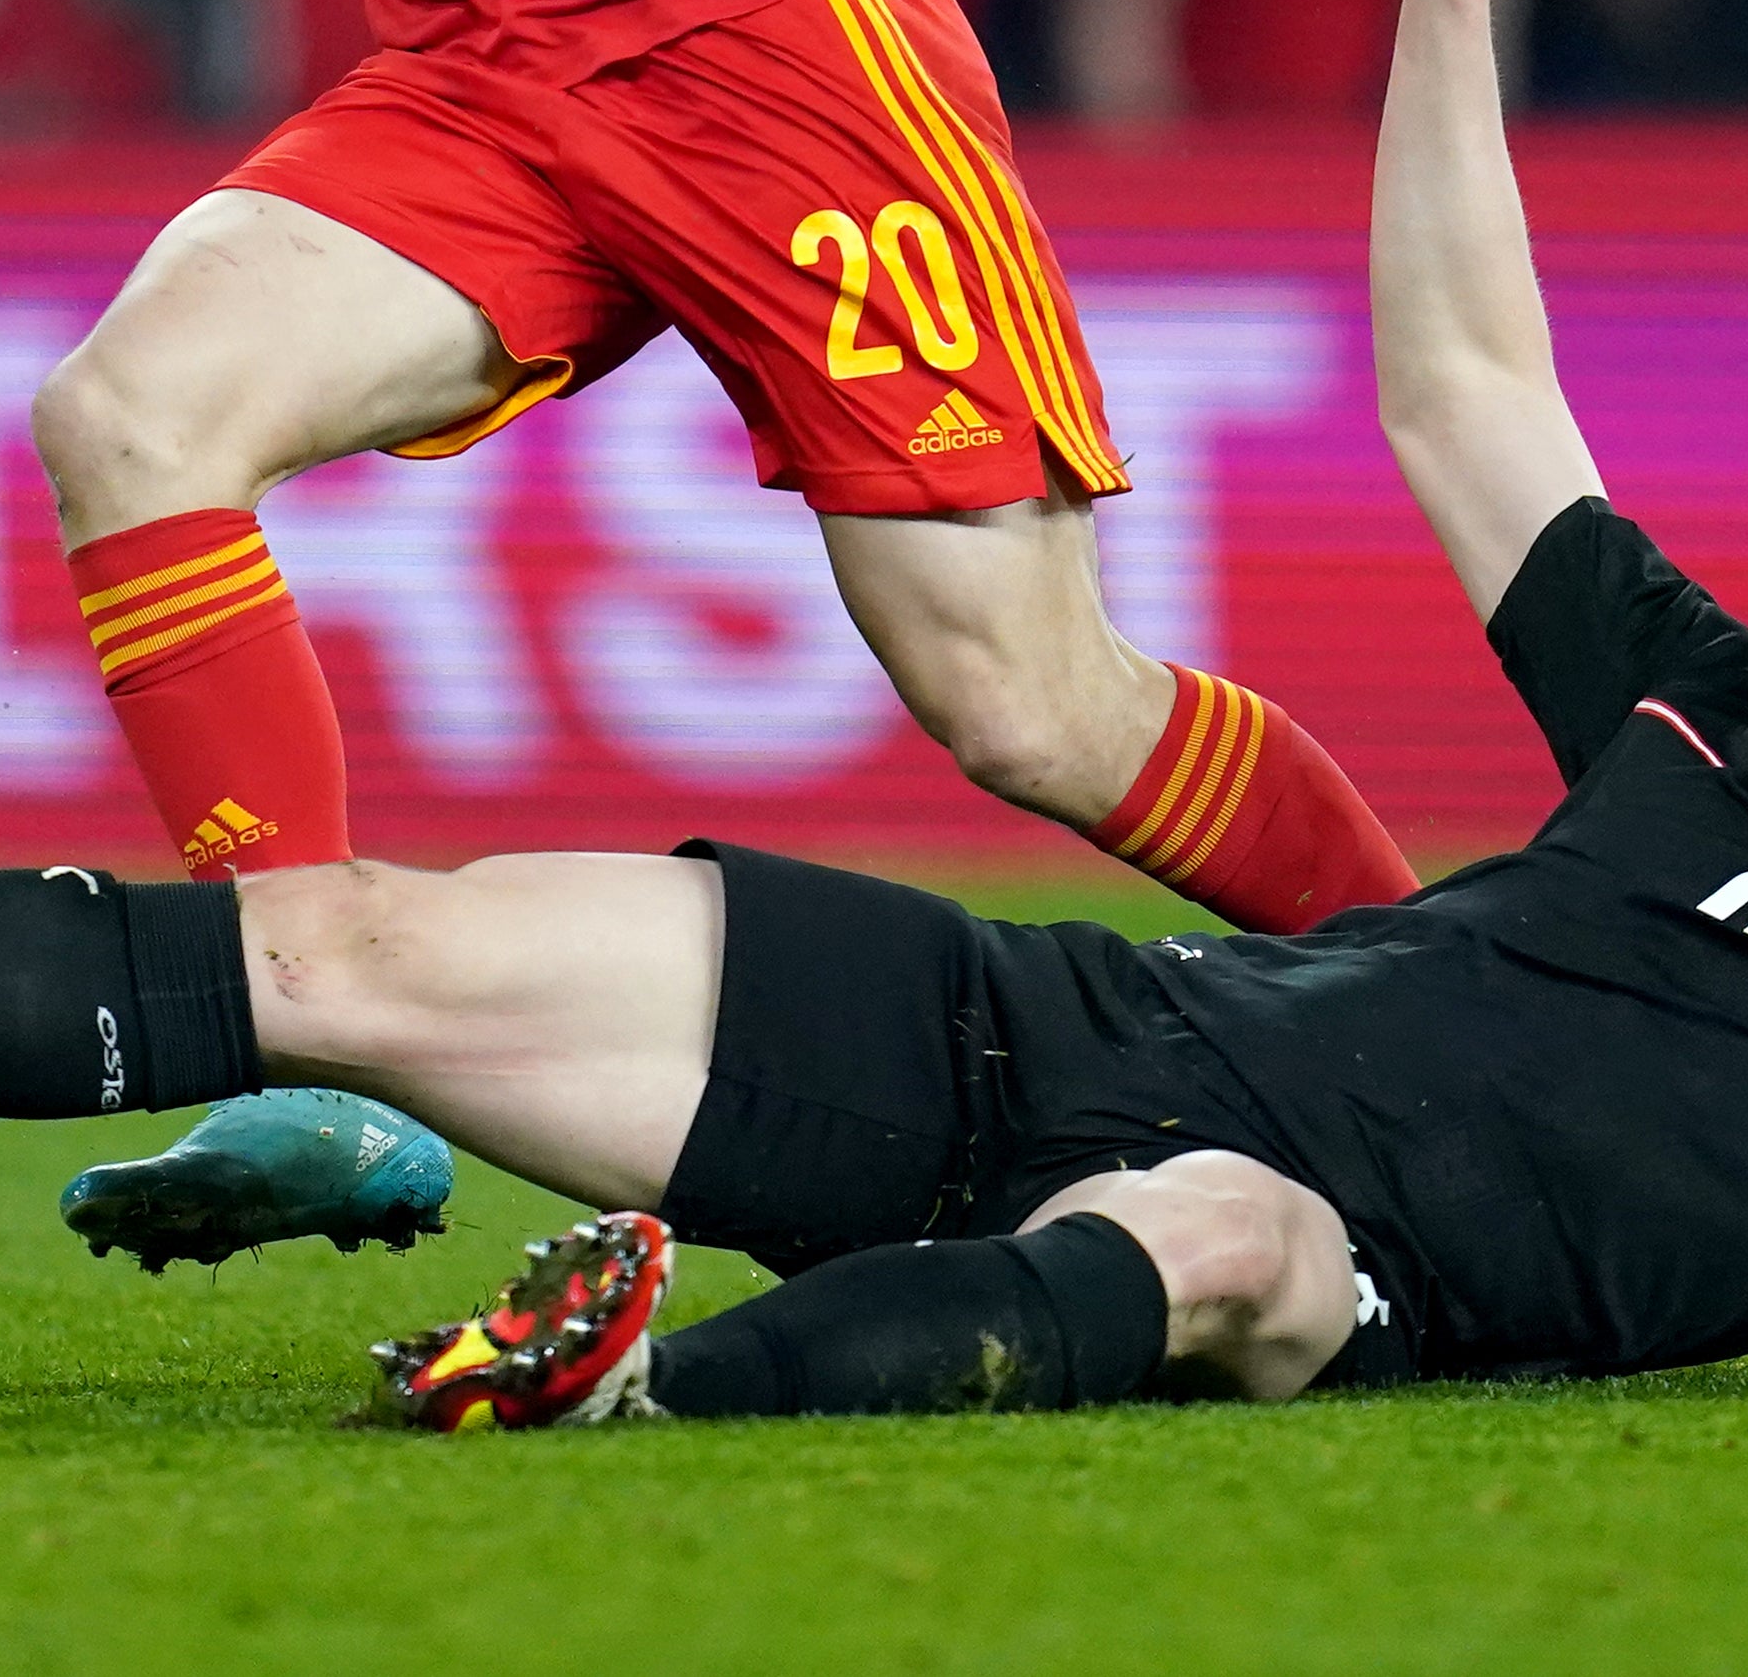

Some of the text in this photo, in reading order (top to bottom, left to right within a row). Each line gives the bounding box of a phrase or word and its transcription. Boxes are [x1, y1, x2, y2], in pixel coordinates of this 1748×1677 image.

[790, 199, 980, 381] 20
[907, 427, 1004, 456] adidas
[184, 821, 279, 870] adidas
[355, 1133, 399, 1172] adidas
